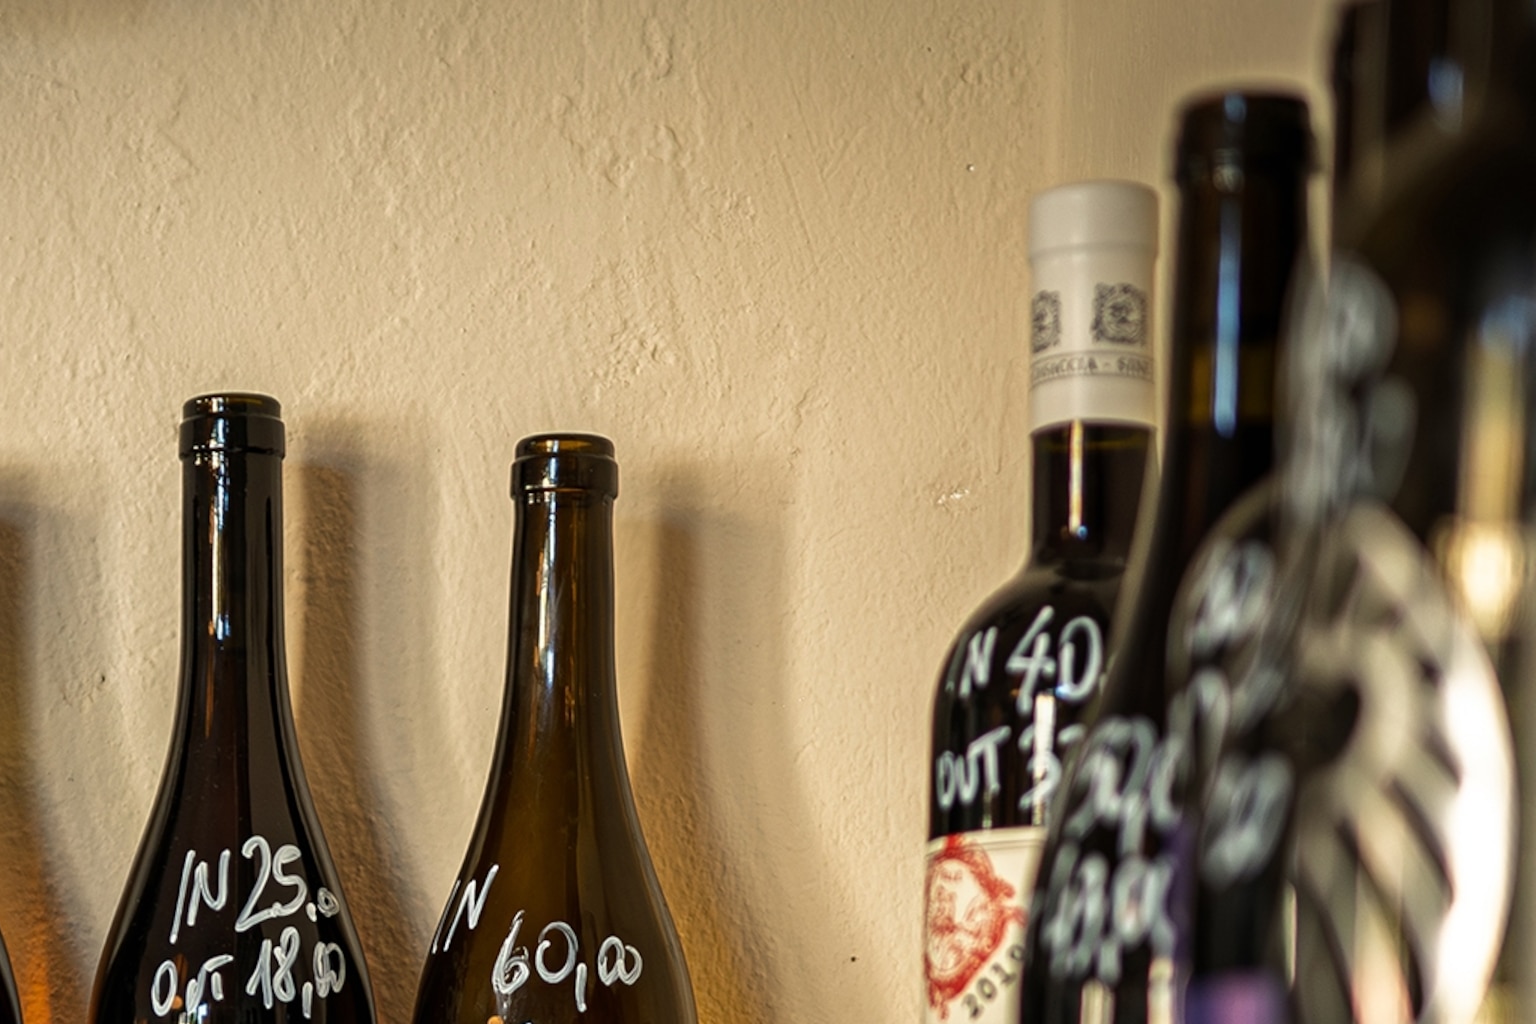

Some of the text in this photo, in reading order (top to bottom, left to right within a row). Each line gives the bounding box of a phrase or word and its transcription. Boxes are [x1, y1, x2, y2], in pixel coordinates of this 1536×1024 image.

[936, 725, 1012, 812] OUT
[170, 849, 231, 944] IN
[431, 864, 500, 954] IN
[151, 953, 234, 1018] OUT
